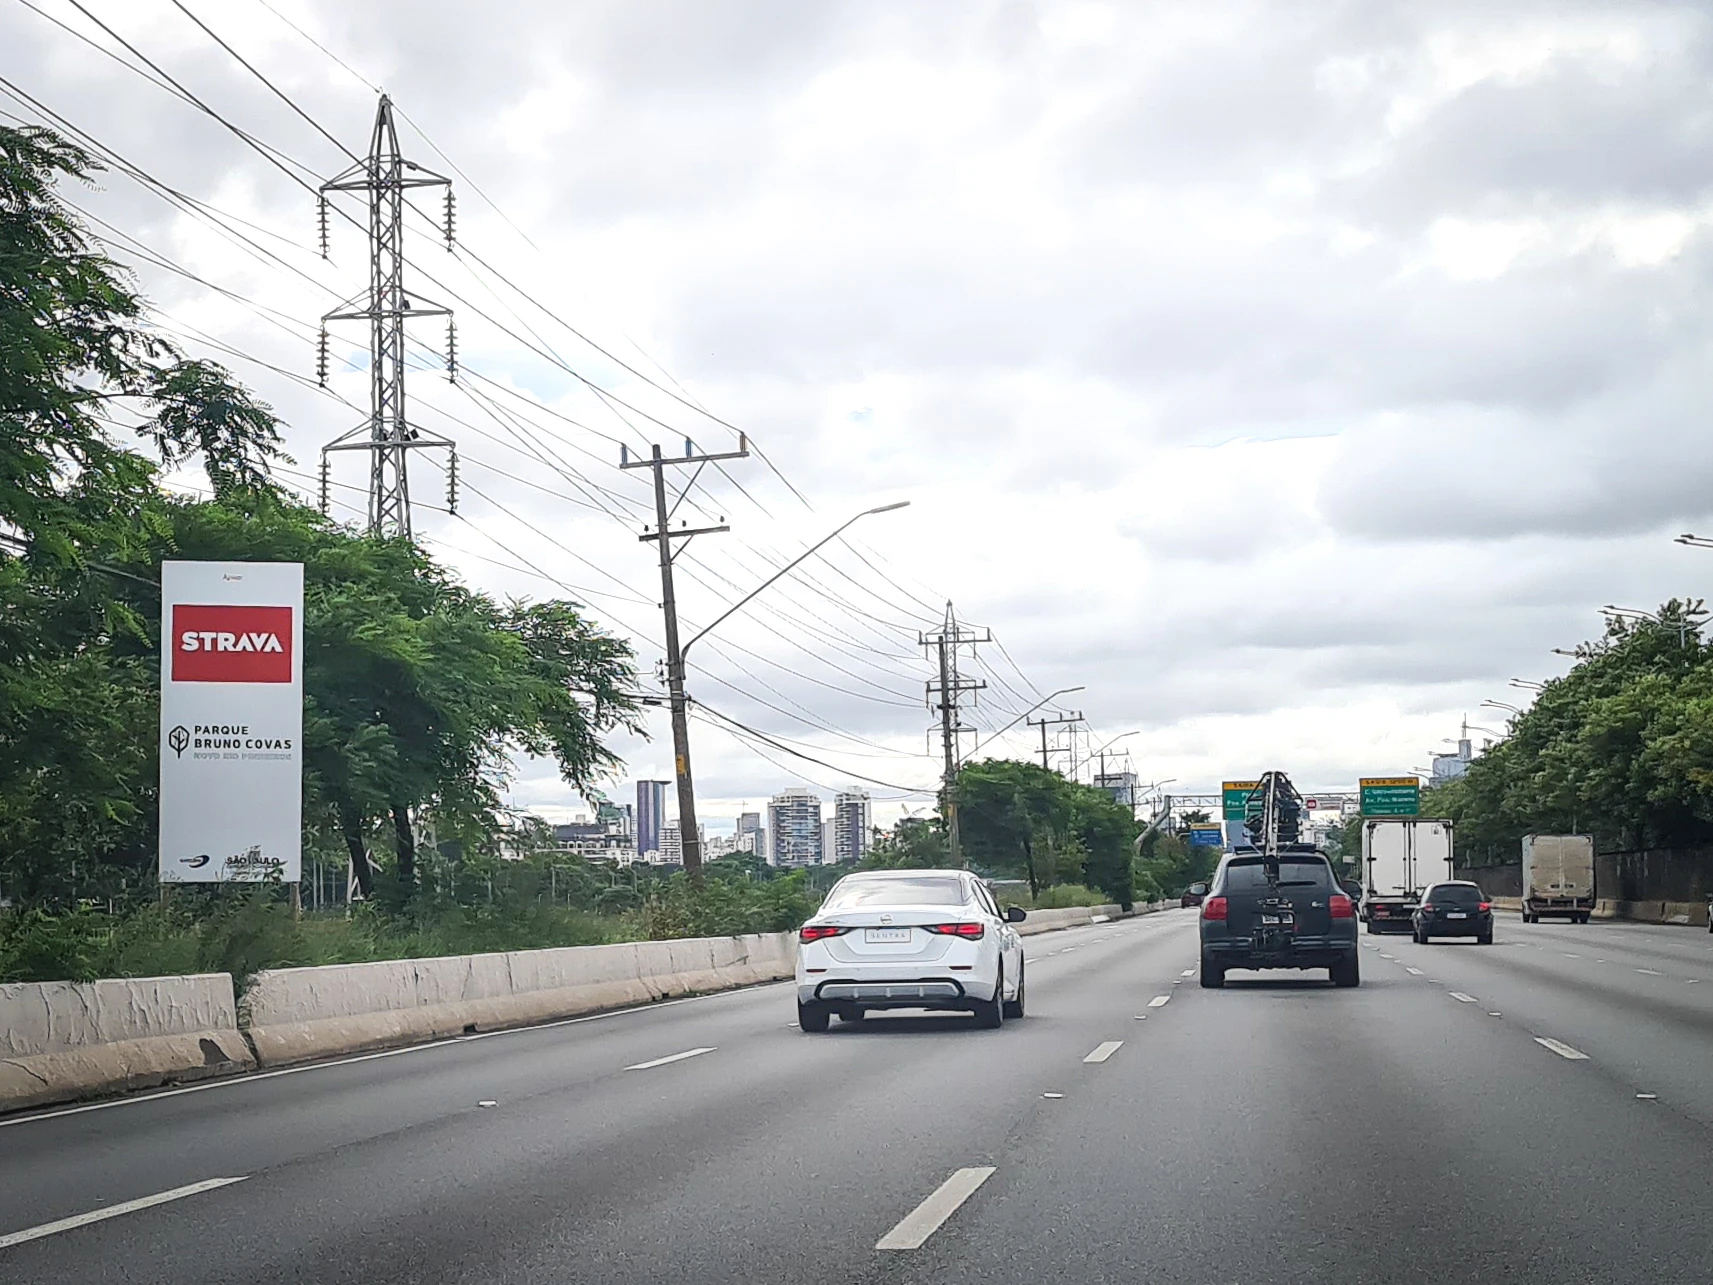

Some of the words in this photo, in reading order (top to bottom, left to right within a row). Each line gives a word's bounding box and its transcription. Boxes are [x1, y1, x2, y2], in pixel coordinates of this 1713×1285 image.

[181, 631, 283, 653] STRAVA
[194, 725, 249, 735] PARQUE
[194, 738, 241, 749] BRUNO
[245, 739, 292, 749] COVAS
